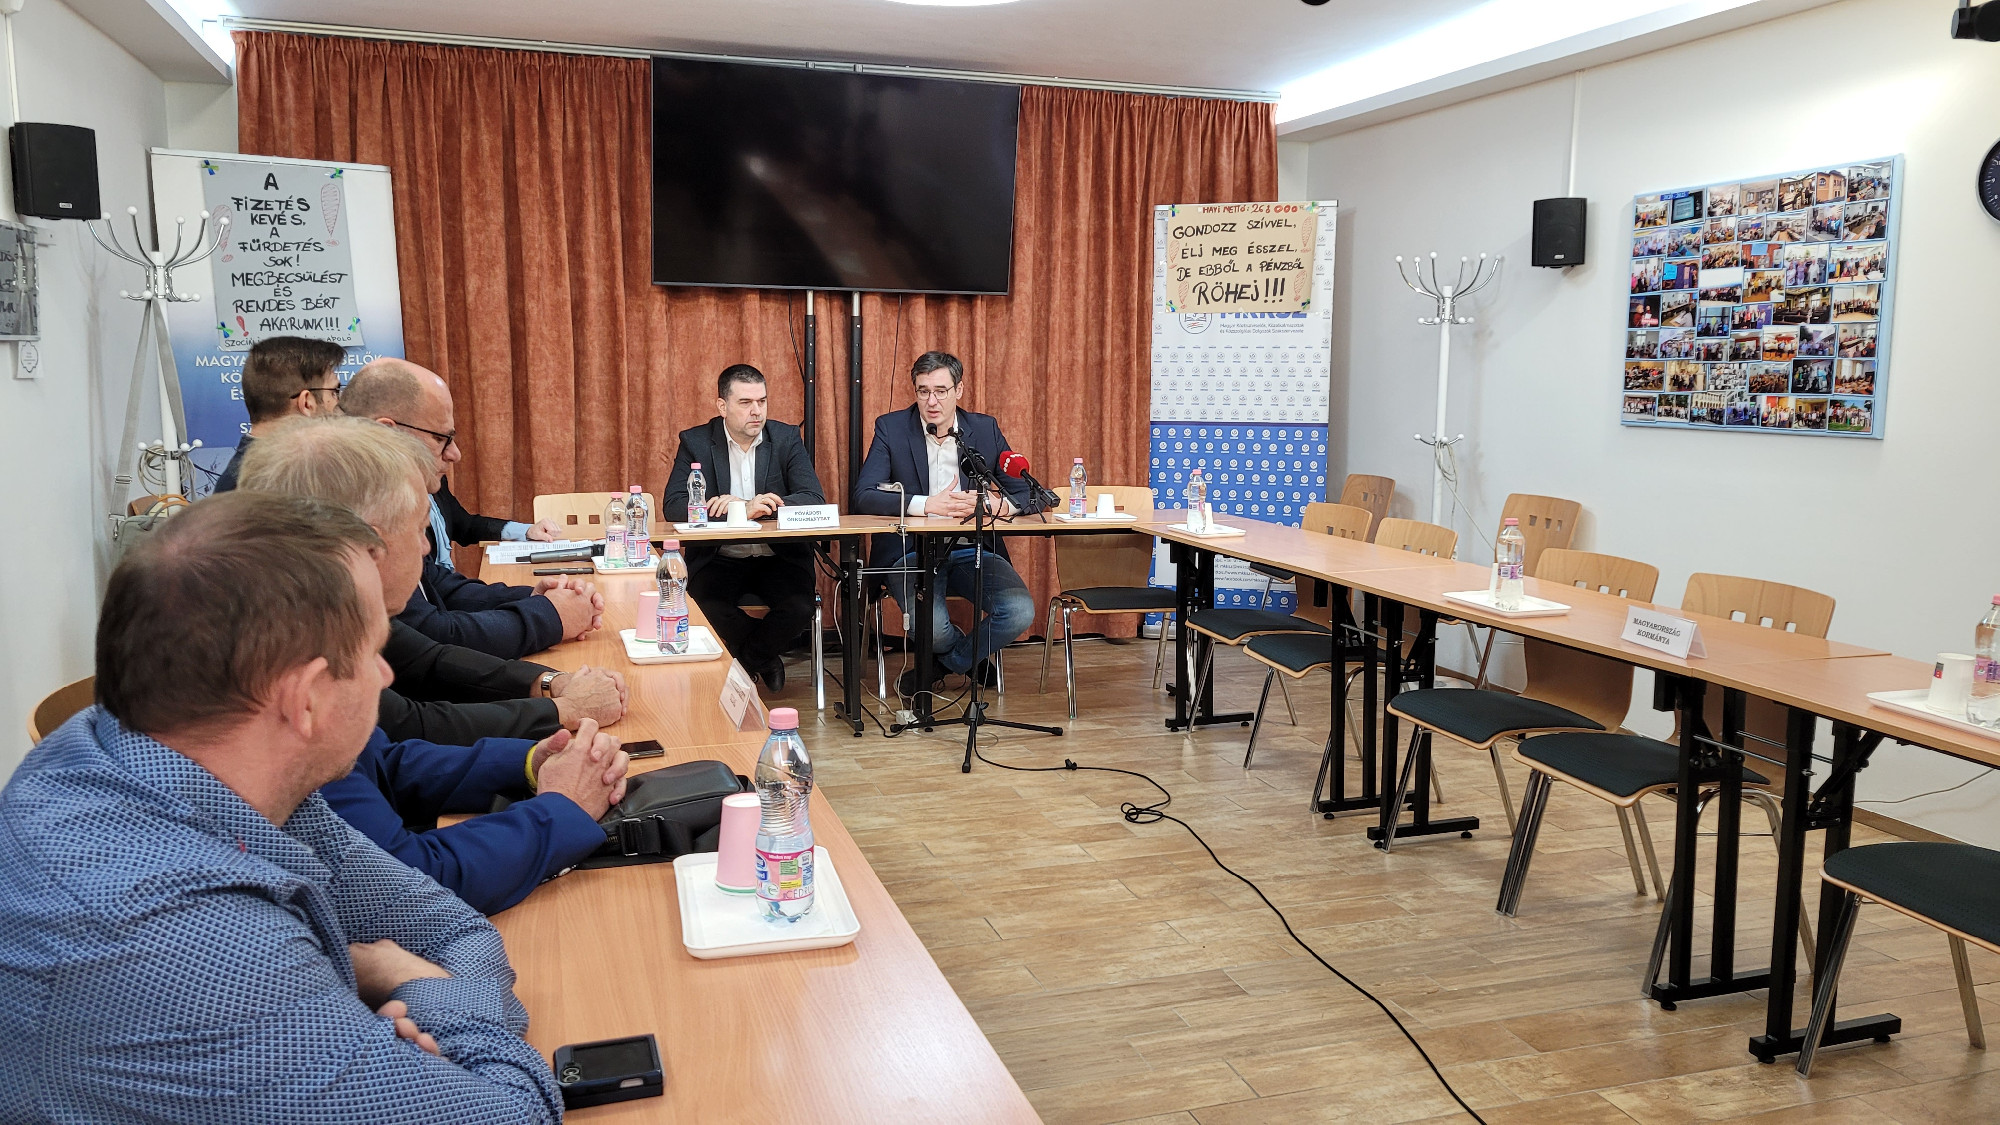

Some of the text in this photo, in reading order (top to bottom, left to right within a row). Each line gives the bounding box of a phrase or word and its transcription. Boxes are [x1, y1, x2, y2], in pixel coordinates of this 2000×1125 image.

[264, 173, 279, 191] A
[1274, 204, 1298, 213] 000
[270, 227, 280, 238] A
[1172, 216, 1296, 240] GONDOZZ SZÍVVEL,
[238, 238, 324, 252] FÜRDETÉS
[1212, 246, 1238, 256] MEG
[1176, 258, 1304, 281] DE EBBŐL A PÉNZBŐL
[231, 270, 348, 287] MEGBECSÜLÉST
[273, 284, 292, 297] ÉS
[232, 294, 340, 314] RENDES BÉRT
[196, 356, 248, 366] MAGYA
[1632, 618, 1680, 637] MAGYARORSZÁG
[1637, 629, 1670, 644] KORMÁNYA
